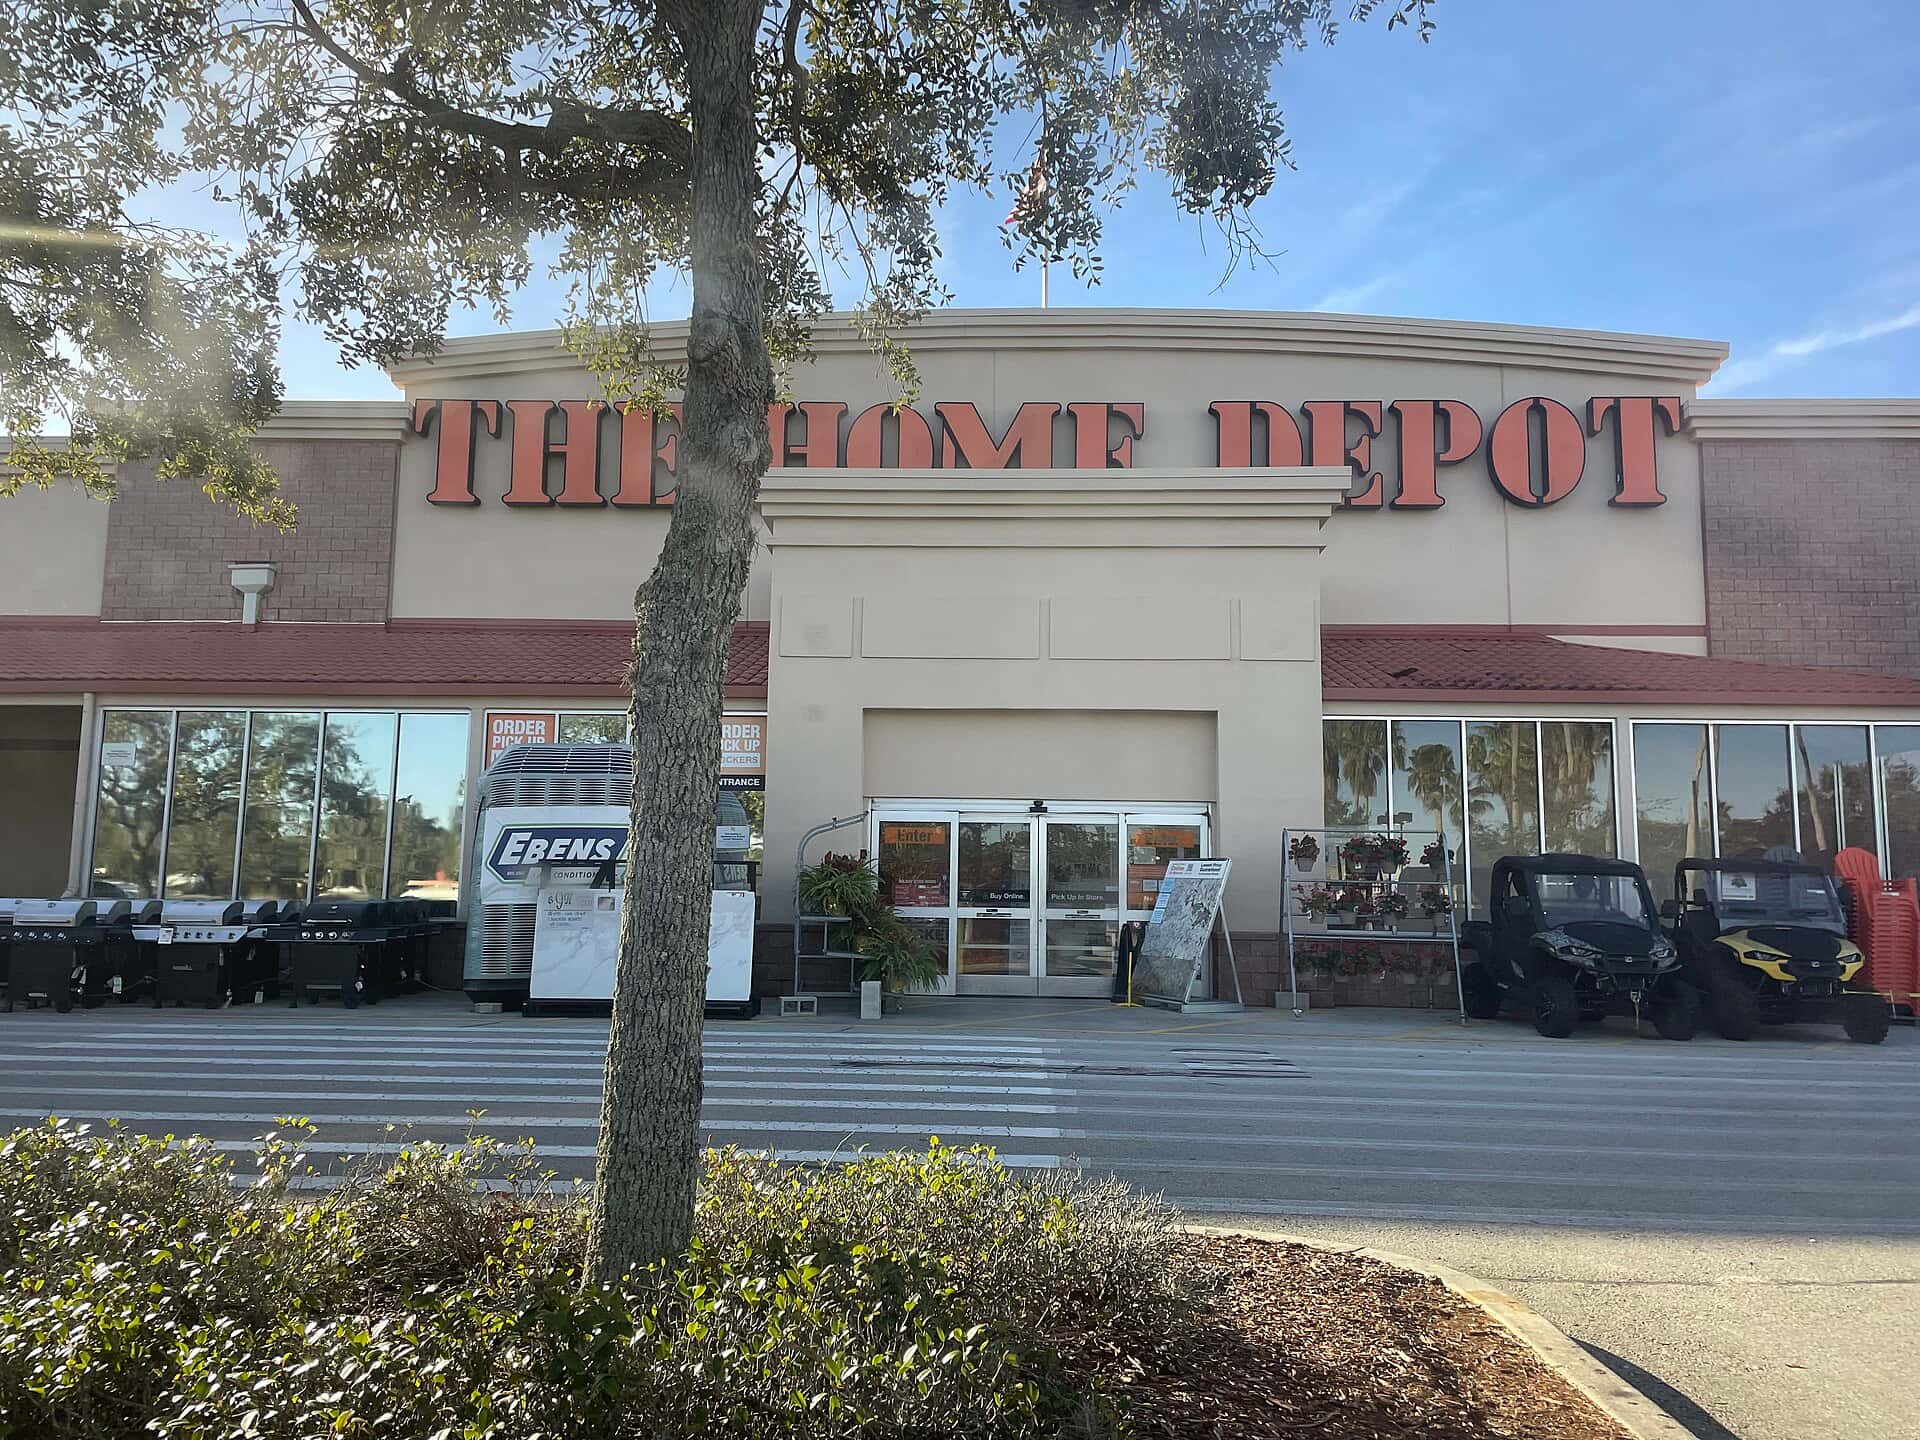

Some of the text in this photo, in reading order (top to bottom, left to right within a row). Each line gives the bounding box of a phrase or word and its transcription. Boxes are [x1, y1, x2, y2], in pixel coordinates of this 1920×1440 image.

[414, 396, 1682, 509] THE HOME DEPOT
[493, 719, 546, 736] ORDER
[722, 724, 760, 739] RDER
[492, 736, 523, 748] PICK
[720, 739, 760, 752] ICK UP
[721, 756, 759, 764] CKERS
[719, 778, 760, 786] NTRANCE
[897, 828, 934, 842] Enter
[498, 831, 616, 865] EBENS
[990, 892, 1024, 901] Buy Online
